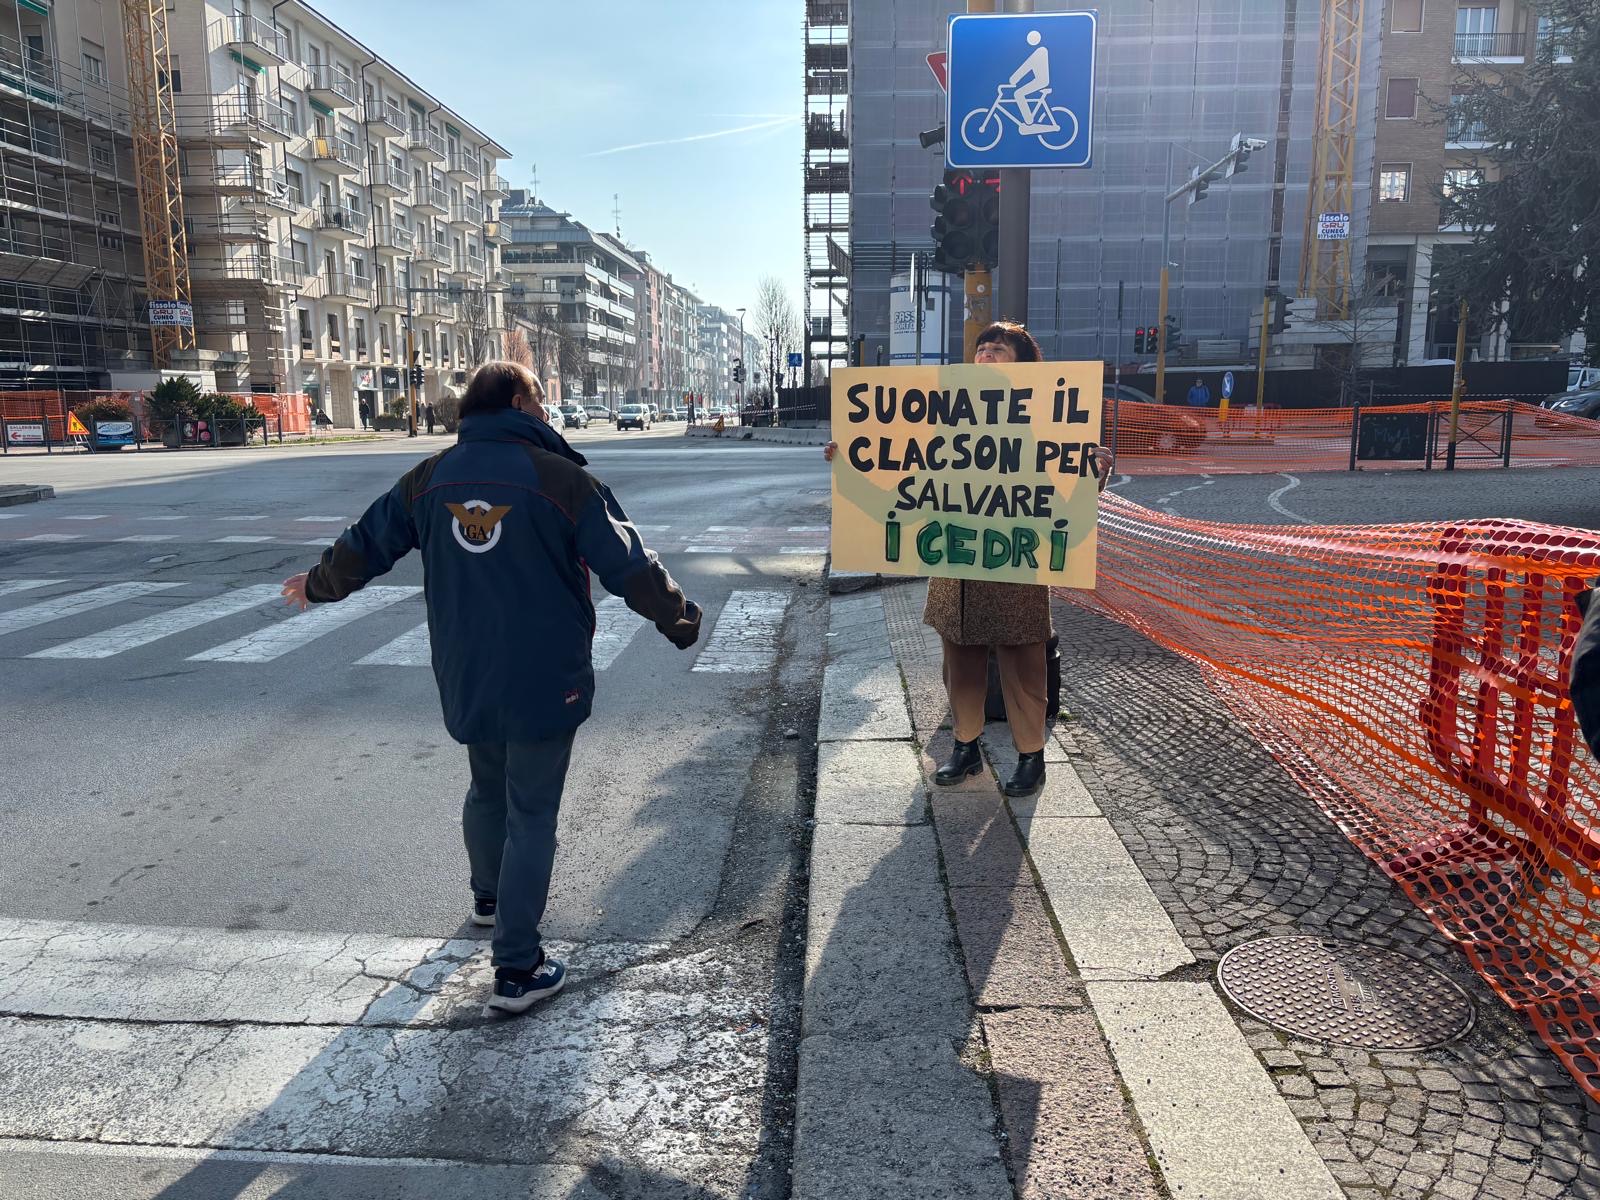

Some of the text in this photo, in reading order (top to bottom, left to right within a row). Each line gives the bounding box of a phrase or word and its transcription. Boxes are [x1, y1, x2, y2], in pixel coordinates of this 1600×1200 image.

[1319, 213, 1349, 221] fissolo
[847, 382, 1034, 427] SUONATE
[848, 433, 1100, 479] CLACSON PER
[894, 476, 1056, 518] SALVARE
